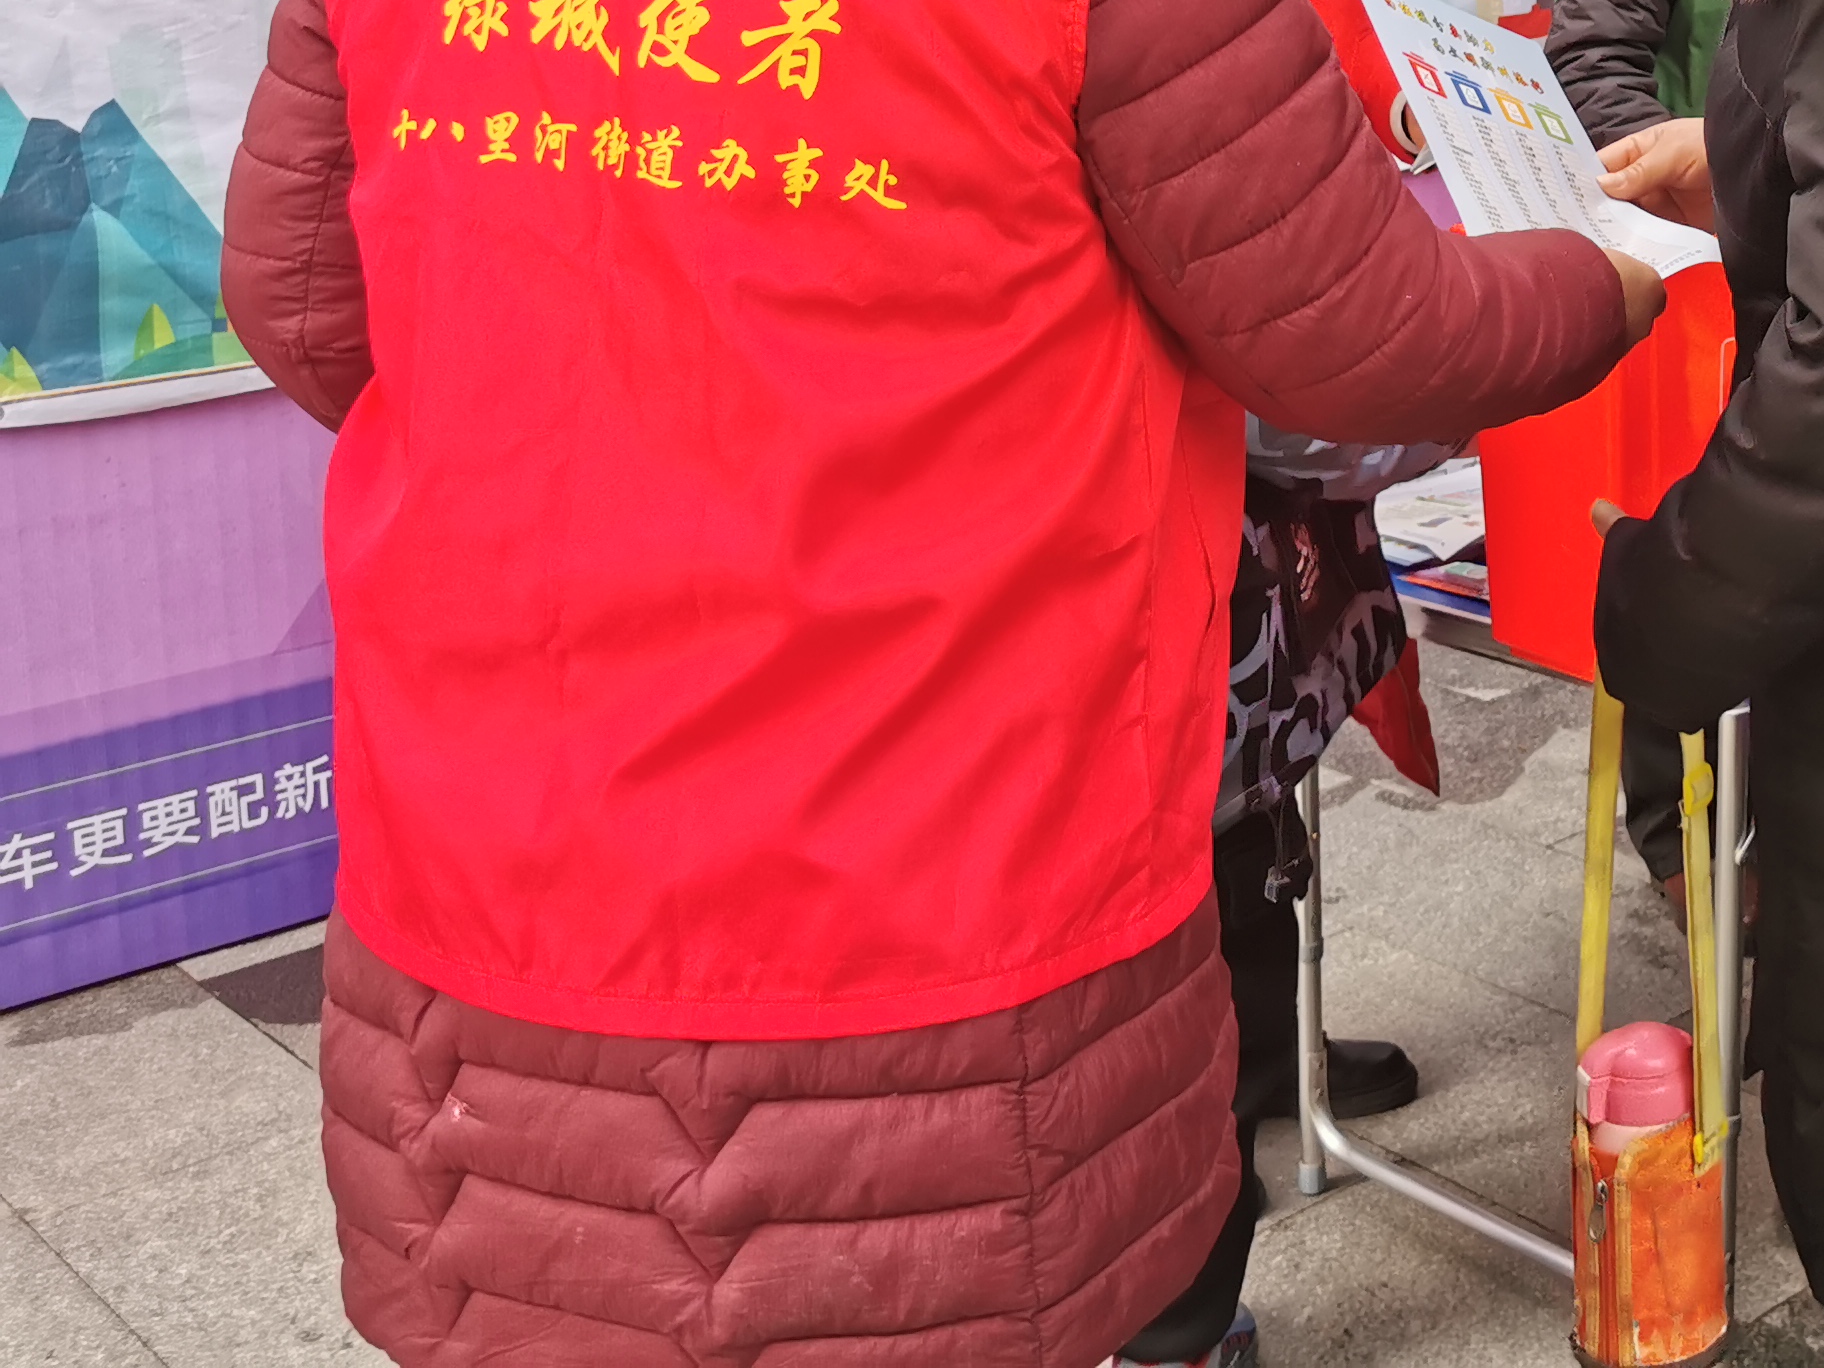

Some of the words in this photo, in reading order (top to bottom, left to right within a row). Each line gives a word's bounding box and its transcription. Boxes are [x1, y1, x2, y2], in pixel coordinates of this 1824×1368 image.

[392, 108, 908, 210] 十八里河街道办事处
[0, 754, 334, 891] 车更要配新
